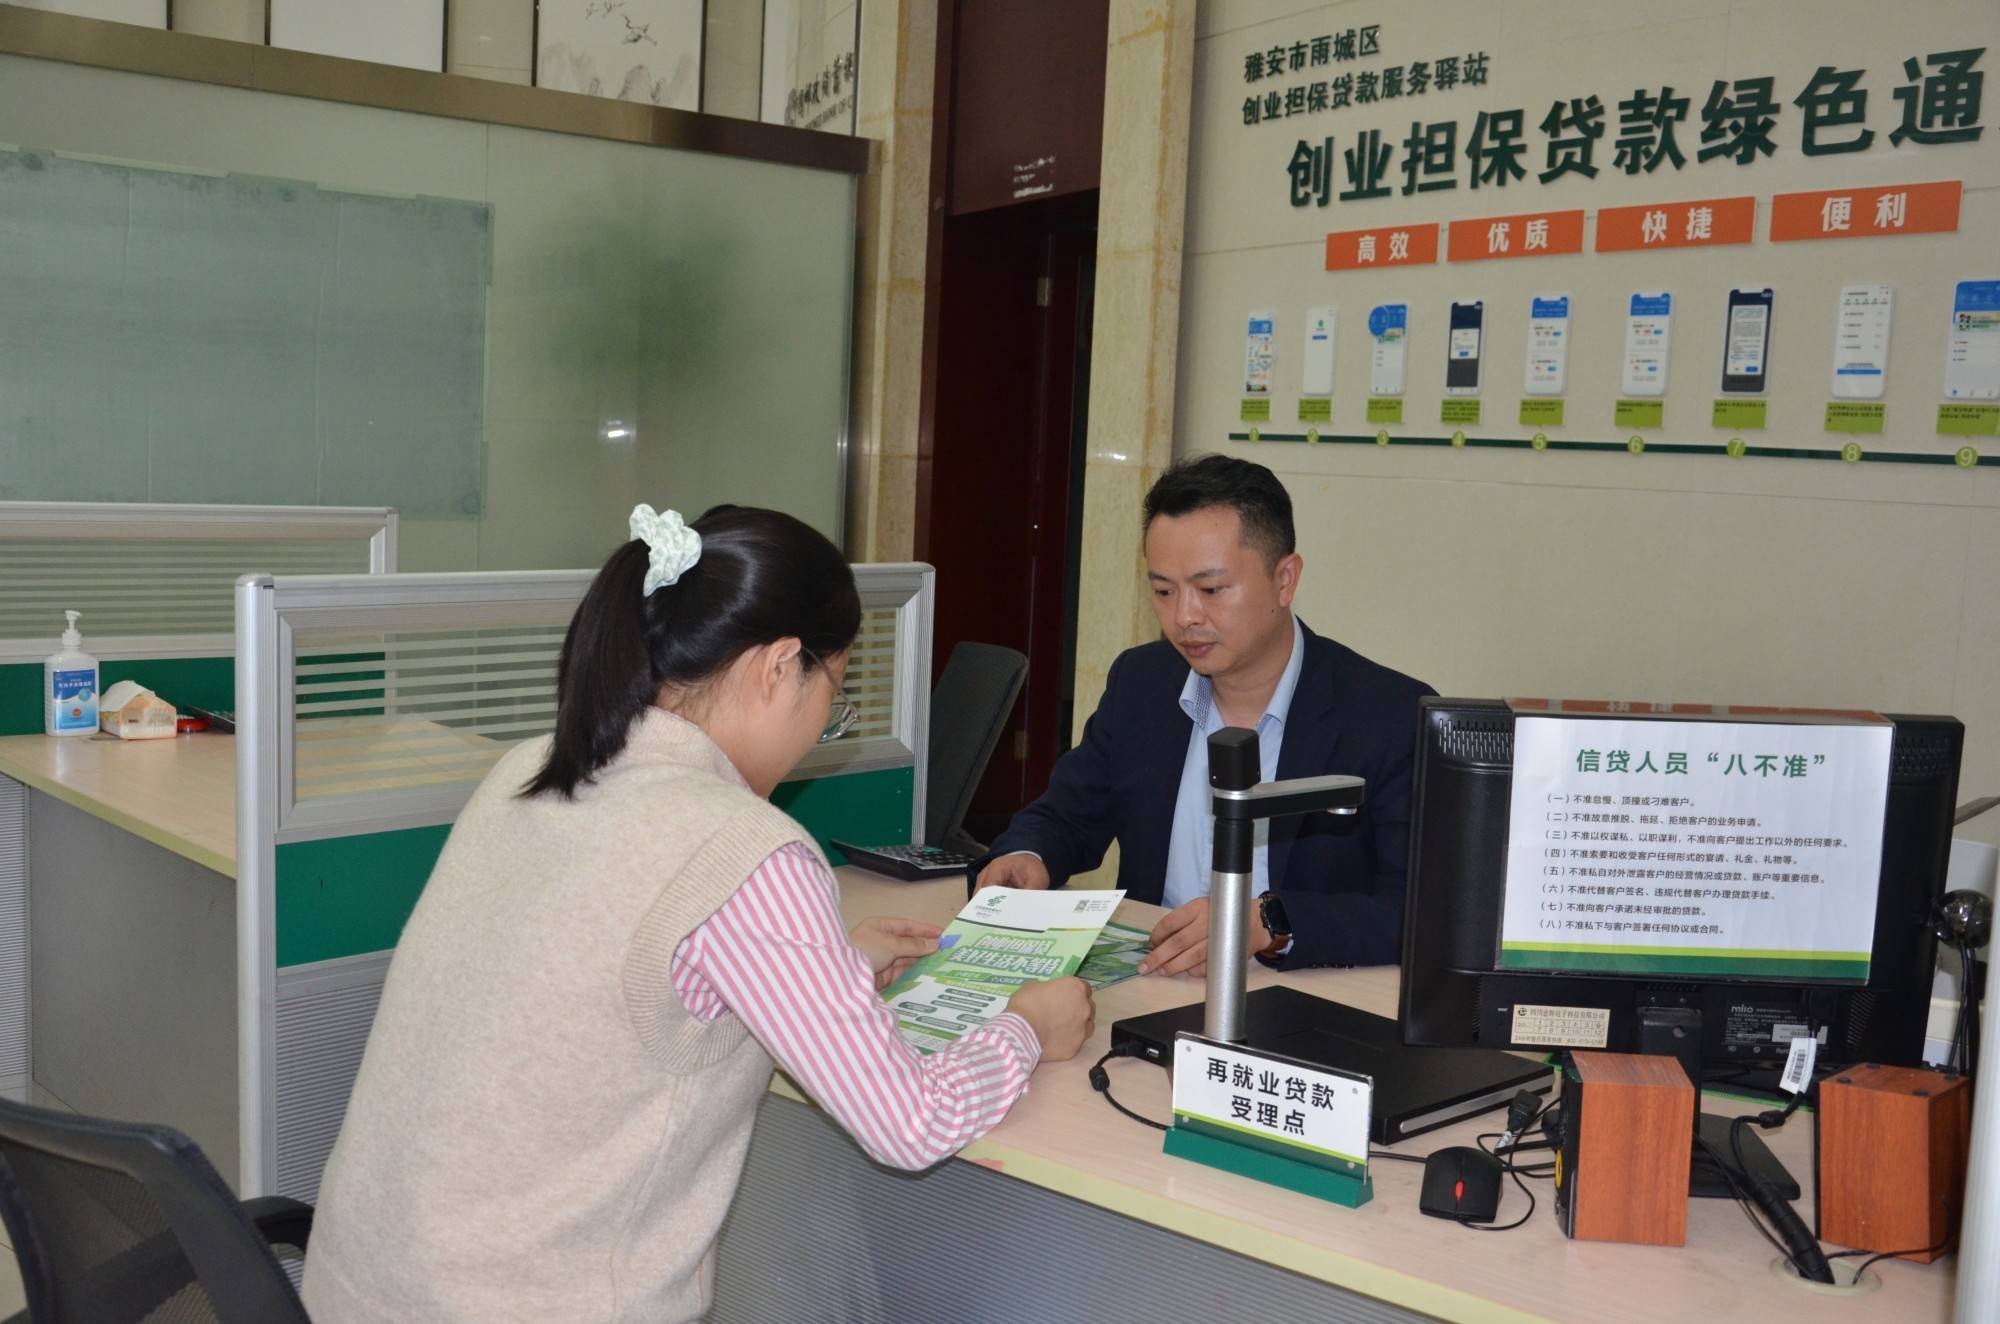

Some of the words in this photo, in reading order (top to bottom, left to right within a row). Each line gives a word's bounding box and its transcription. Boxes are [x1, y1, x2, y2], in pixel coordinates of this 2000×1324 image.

[1244, 24, 1381, 83] 雅安市雨城区
[1242, 51, 1490, 125] 创业担保贷款服务驿站
[1287, 47, 1987, 208] 创业担保贷款绿色通
[1642, 207, 1712, 243] 快捷
[1821, 193, 1907, 231] 便利
[1357, 231, 1410, 263] 高效
[1487, 218, 1549, 254] 优质
[1206, 1057, 1335, 1111] 再就业贷款
[1231, 1095, 1306, 1135] 受理点
